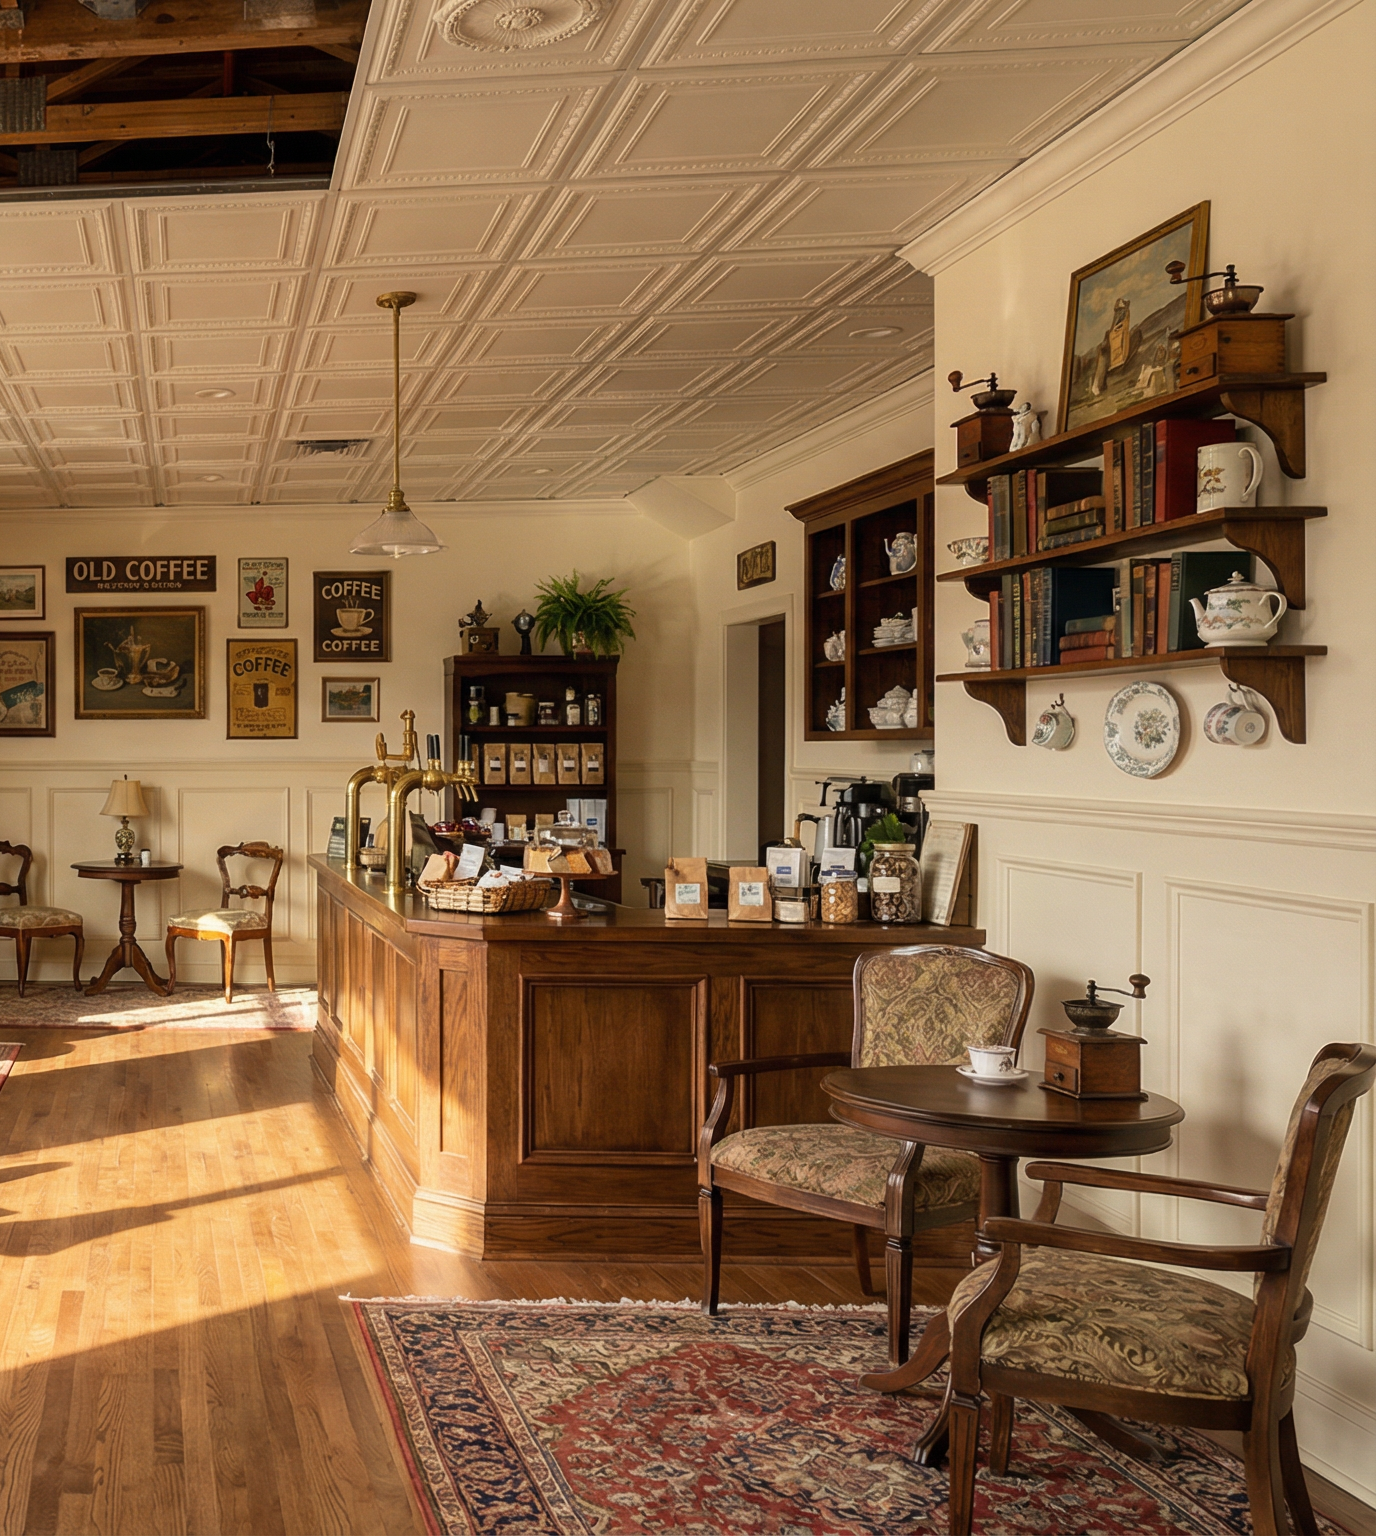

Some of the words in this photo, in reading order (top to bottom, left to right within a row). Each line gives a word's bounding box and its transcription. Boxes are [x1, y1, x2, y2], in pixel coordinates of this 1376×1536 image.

[73, 561, 116, 581] OLD
[125, 560, 209, 581] COFFEE
[321, 580, 382, 600] COFFEE
[322, 640, 380, 652] COFFEE
[232, 656, 292, 677] COFFEE
